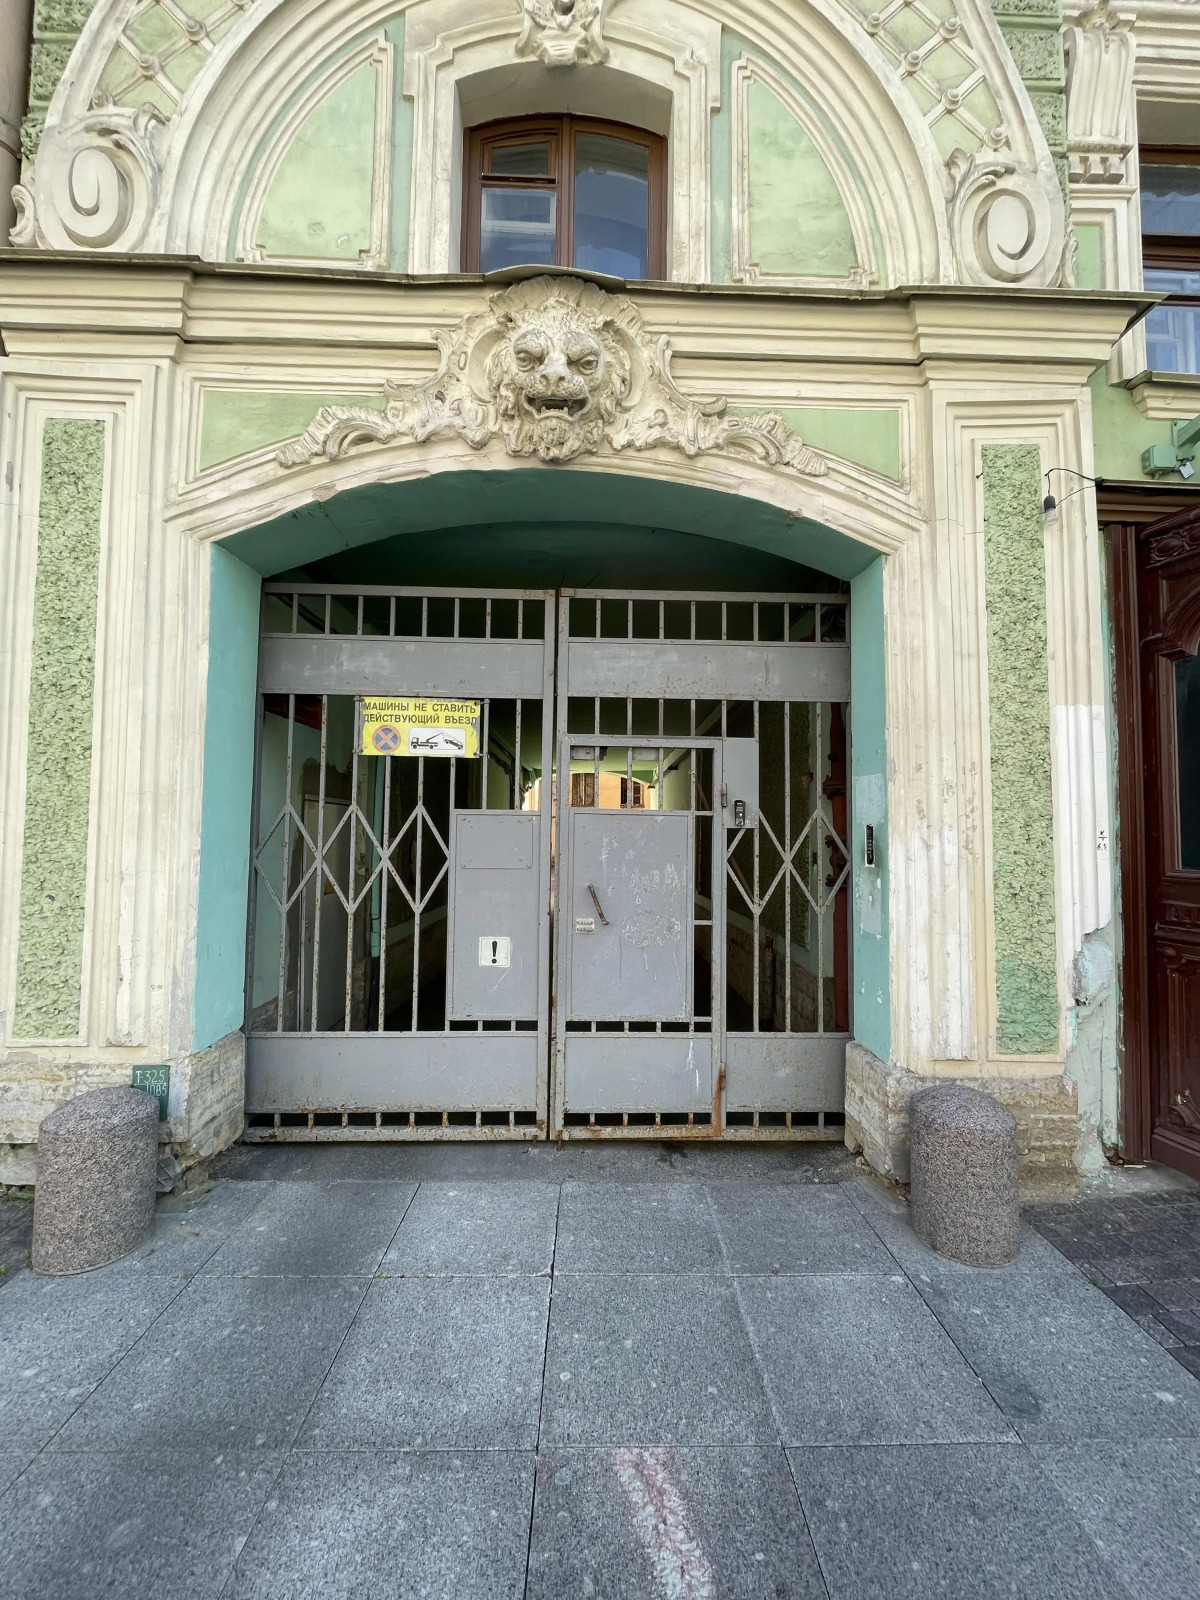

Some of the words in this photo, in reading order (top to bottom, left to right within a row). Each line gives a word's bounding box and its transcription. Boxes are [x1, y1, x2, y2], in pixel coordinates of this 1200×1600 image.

[364, 702, 409, 711] МАШИНЫ
[414, 703, 427, 712] НЕ
[432, 703, 476, 713] СТАВИТЬ
[363, 712, 440, 724] ДЕЙСТВУЮЩИЙ
